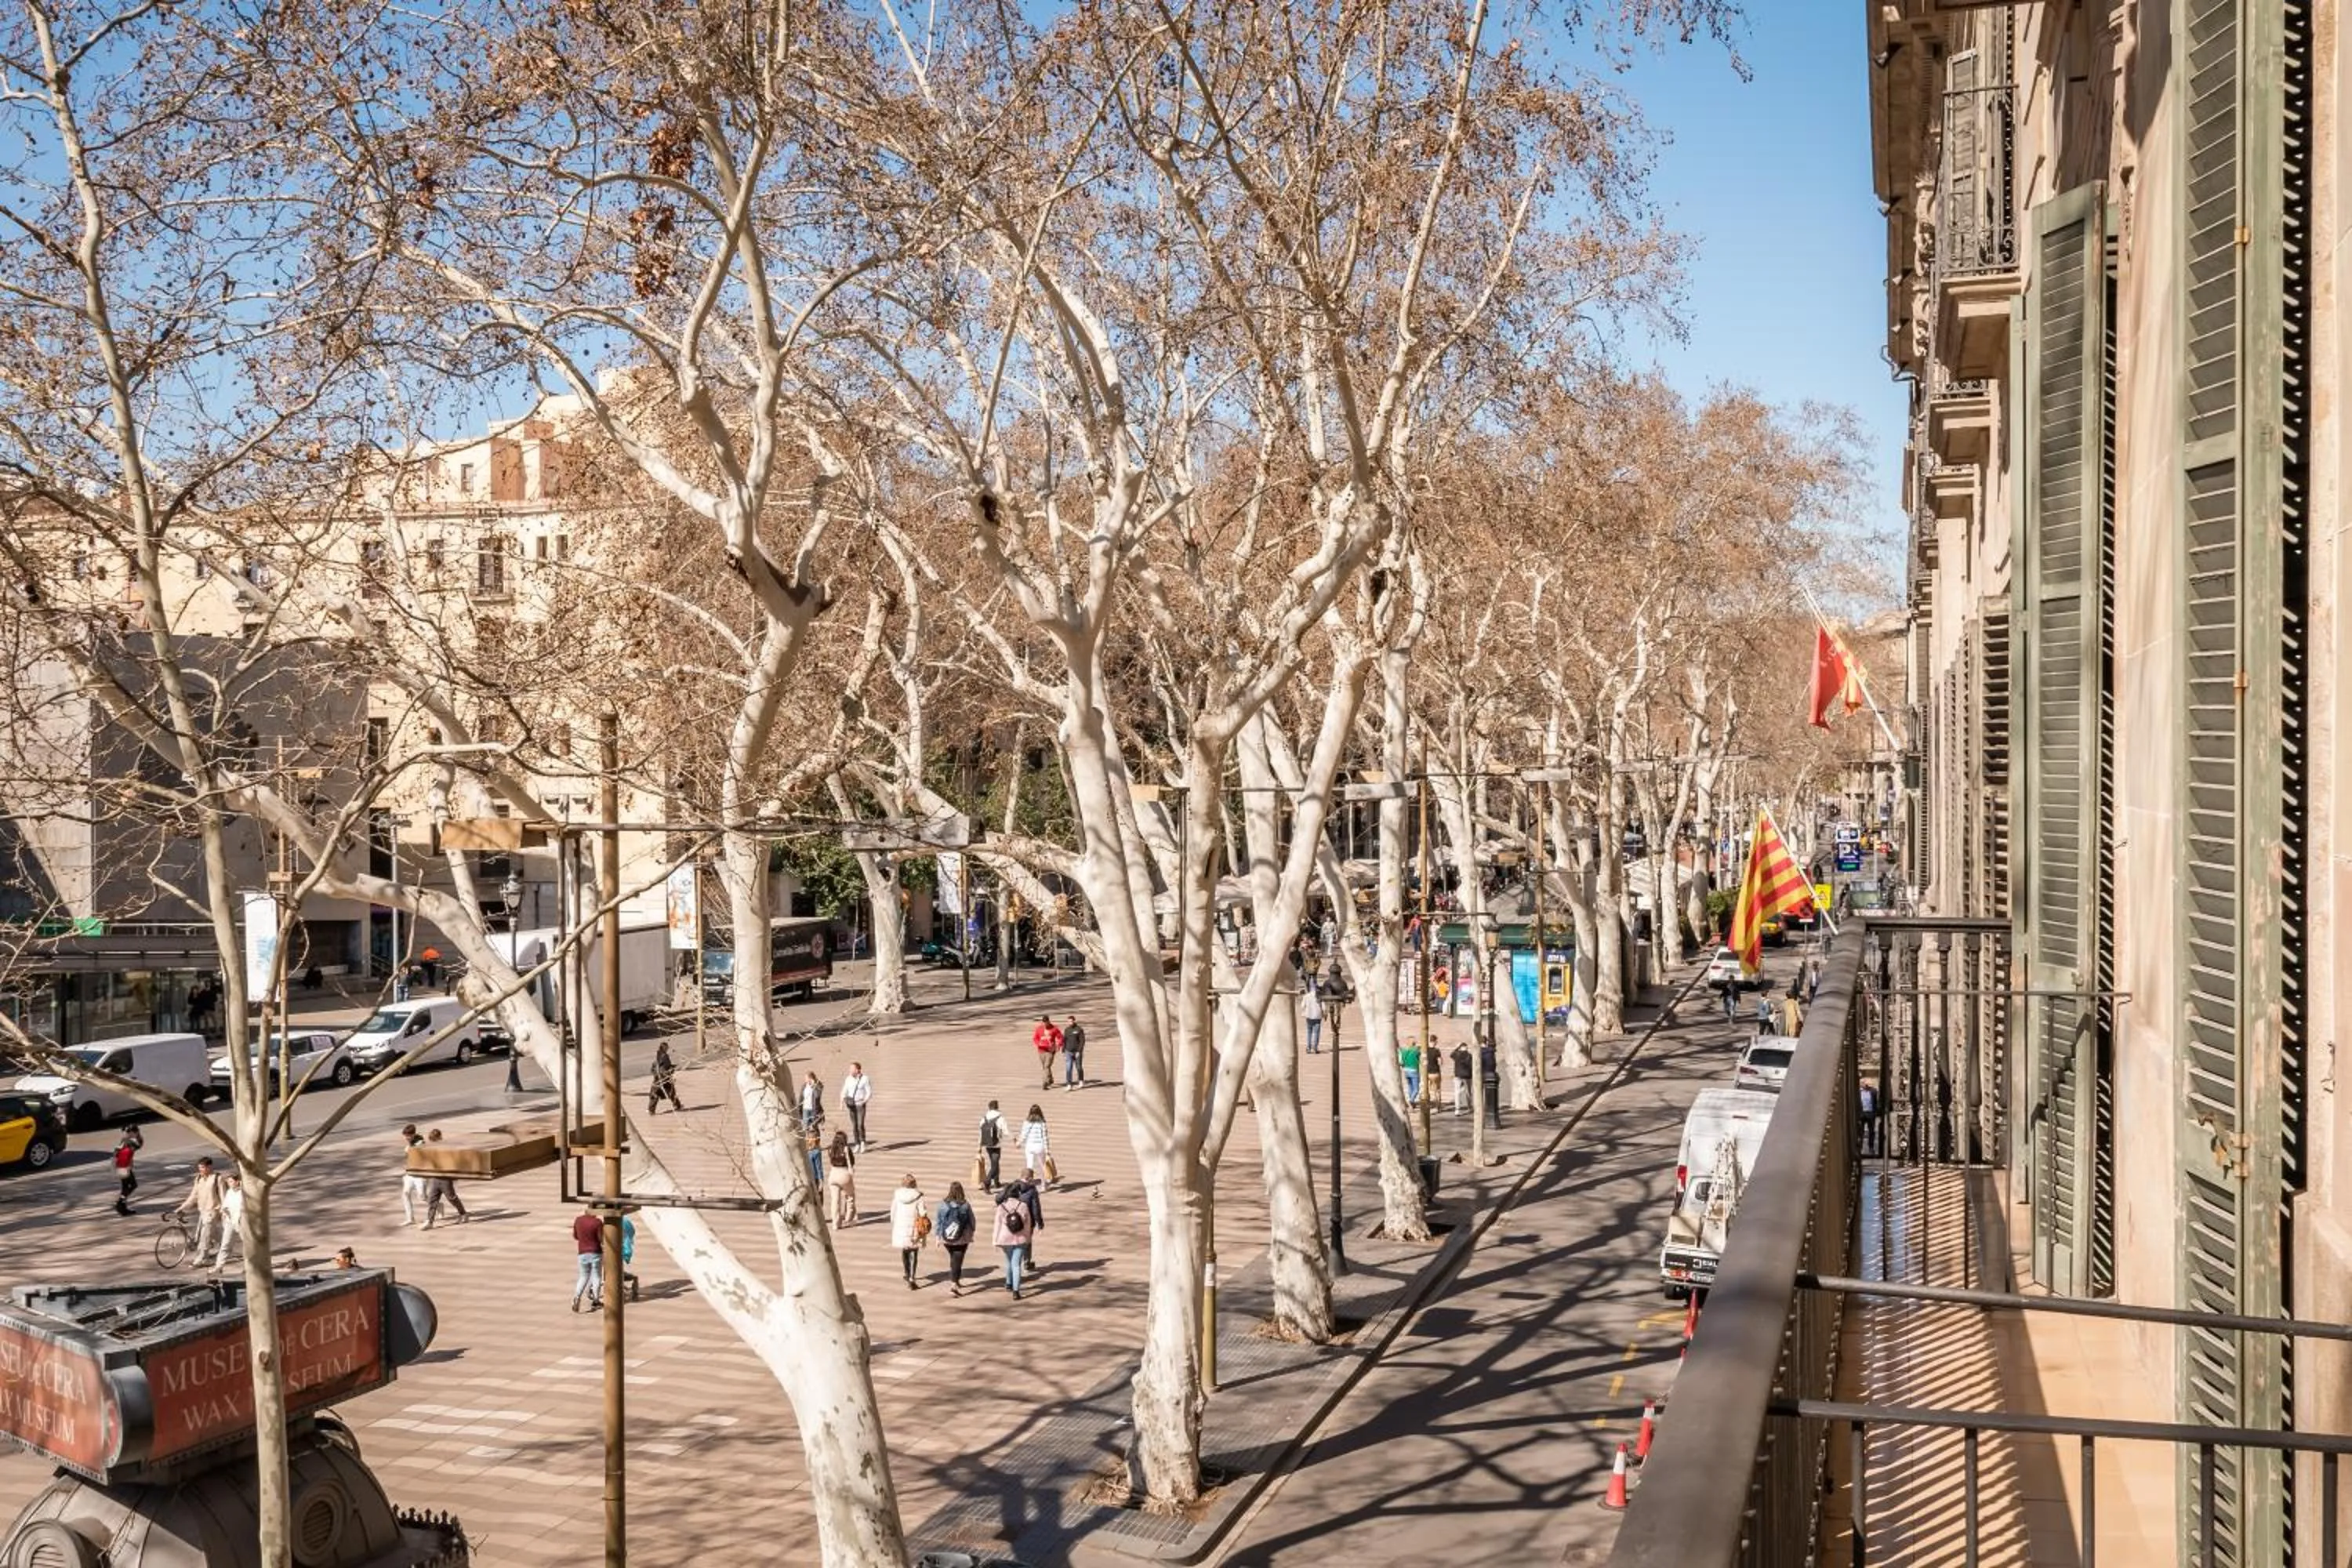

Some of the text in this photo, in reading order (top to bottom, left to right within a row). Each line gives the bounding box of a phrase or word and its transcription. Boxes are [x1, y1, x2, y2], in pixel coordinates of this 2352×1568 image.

[1, 1340, 27, 1379] SEU
[42, 1359, 87, 1406] CERA
[162, 1341, 247, 1398] MUSE
[300, 1305, 369, 1350] CERA
[15, 1393, 75, 1446] MUSEUM
[181, 1389, 240, 1432] WAX
